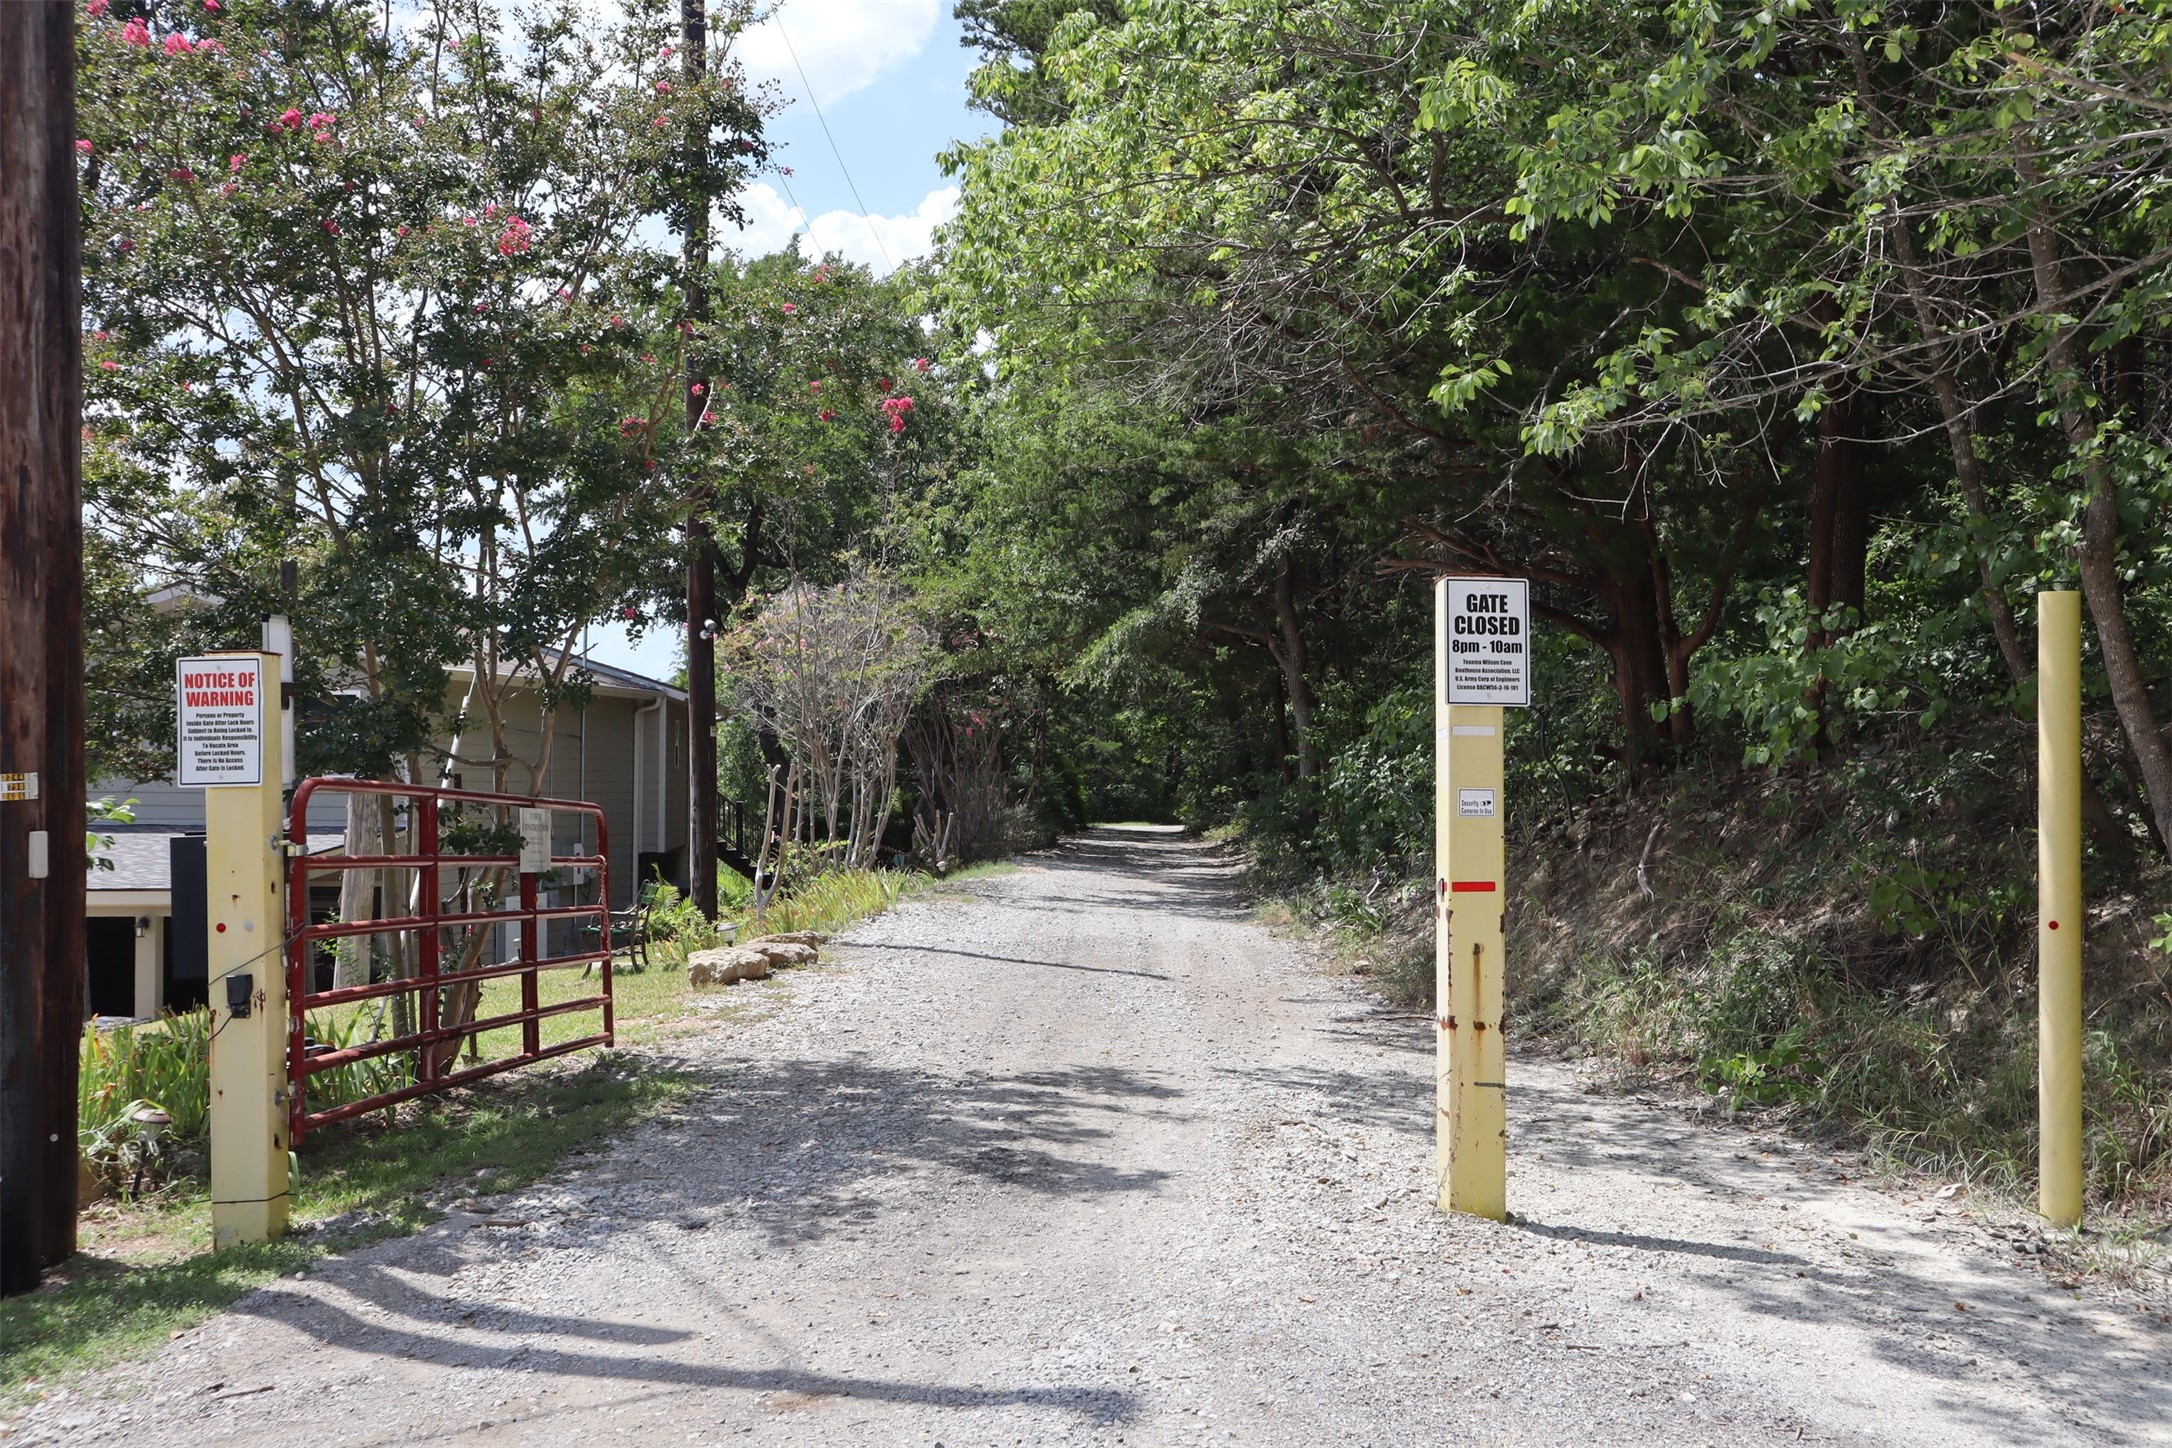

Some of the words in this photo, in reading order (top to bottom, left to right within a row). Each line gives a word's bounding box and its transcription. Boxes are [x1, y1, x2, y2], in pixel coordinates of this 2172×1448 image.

[1467, 594, 1508, 613] GATE
[1455, 616, 1519, 635] CLOSED
[1452, 640, 1479, 653] 8pm
[1490, 640, 1522, 653] 10am
[184, 673, 234, 688] NOTICE
[238, 672, 255, 687] OF
[186, 691, 253, 707] WARNING
